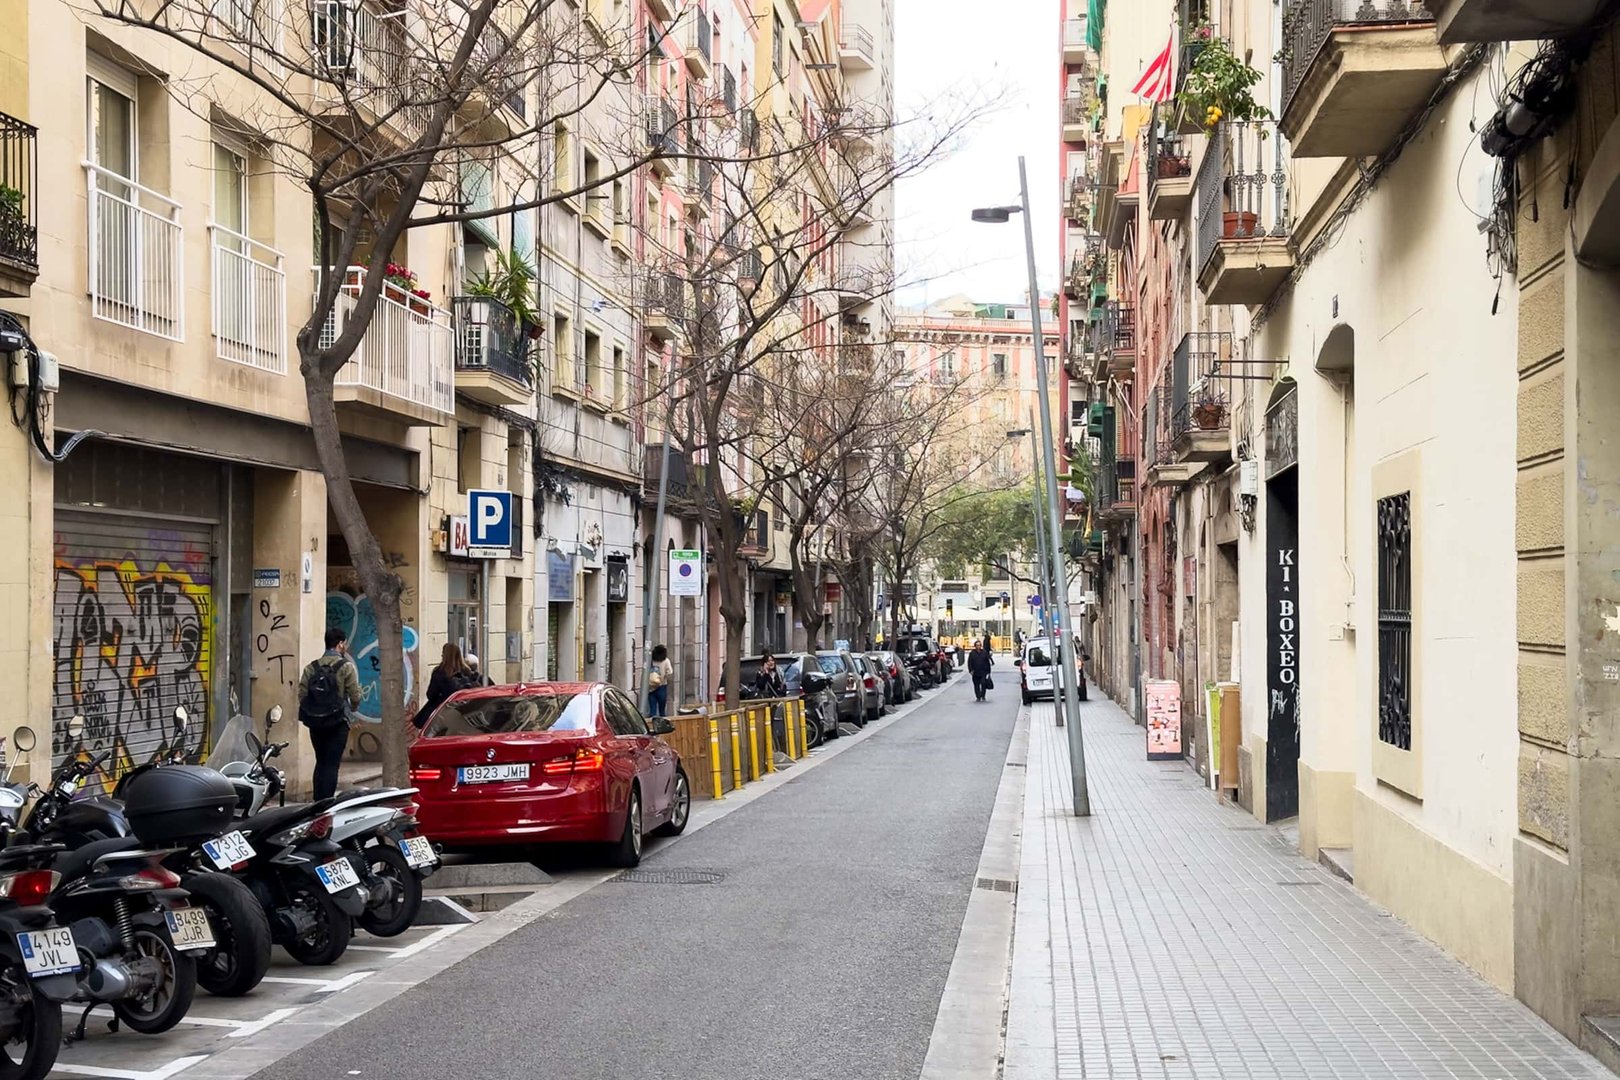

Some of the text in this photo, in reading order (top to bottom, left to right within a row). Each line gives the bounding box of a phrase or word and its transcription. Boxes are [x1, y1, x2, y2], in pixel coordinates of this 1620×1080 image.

[477, 496, 504, 539] P
[1279, 600, 1295, 684] BOXEO
[466, 765, 527, 779] 9923 JMH
[212, 833, 245, 853] 7312
[224, 845, 249, 863] LJG
[411, 850, 430, 863] HRS
[324, 860, 350, 877] 5879
[330, 873, 352, 889] KNL
[175, 911, 206, 927] 8499
[33, 930, 72, 949] 4149
[182, 926, 205, 941] JJR
[39, 949, 68, 967] JVL
